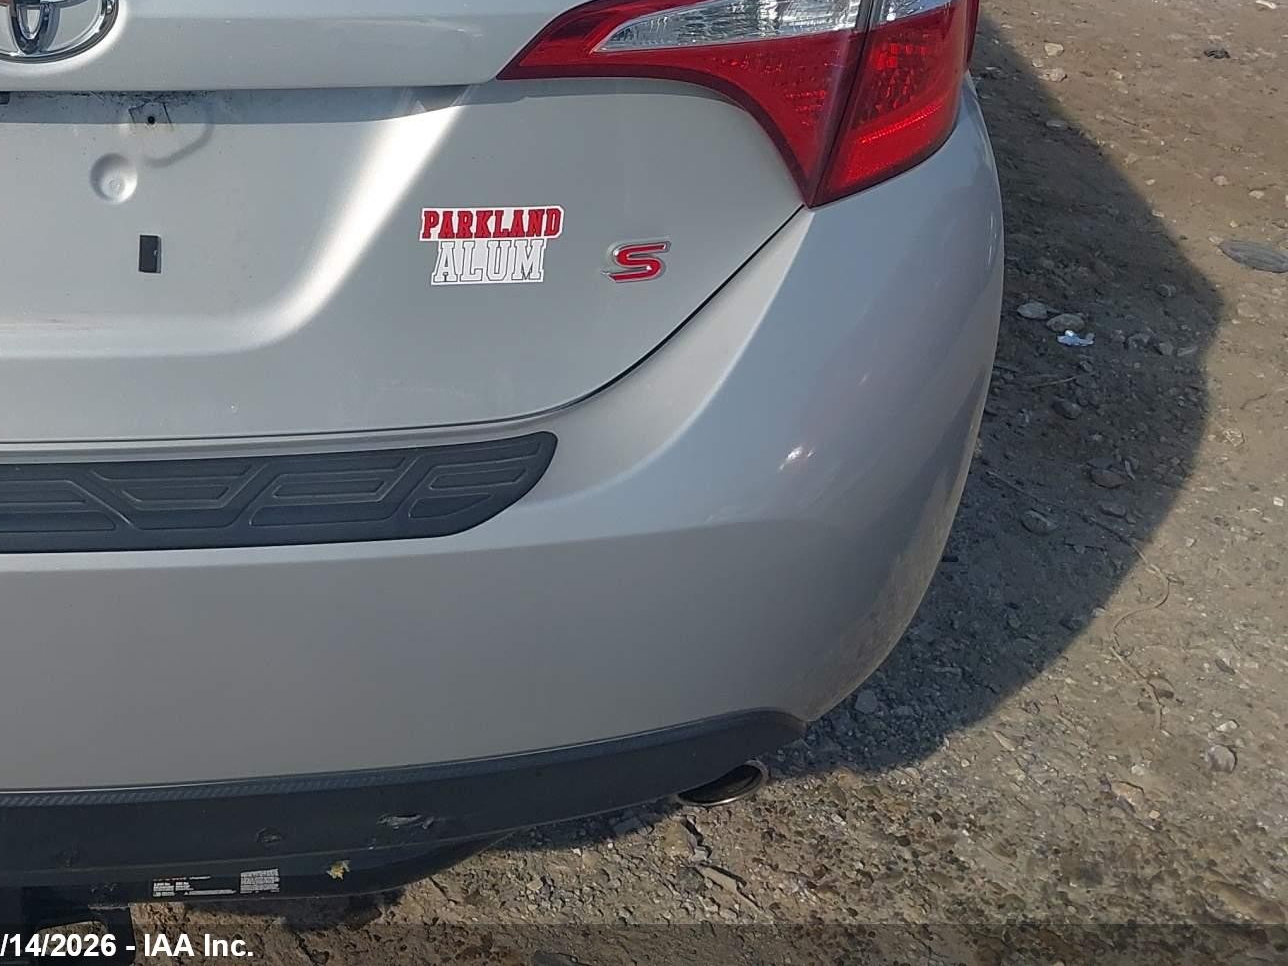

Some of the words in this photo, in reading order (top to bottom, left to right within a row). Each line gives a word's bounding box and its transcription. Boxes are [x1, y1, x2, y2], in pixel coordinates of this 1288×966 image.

[422, 209, 562, 239] PARKLAND
[433, 240, 544, 282] ALUM
[602, 241, 670, 282] S
